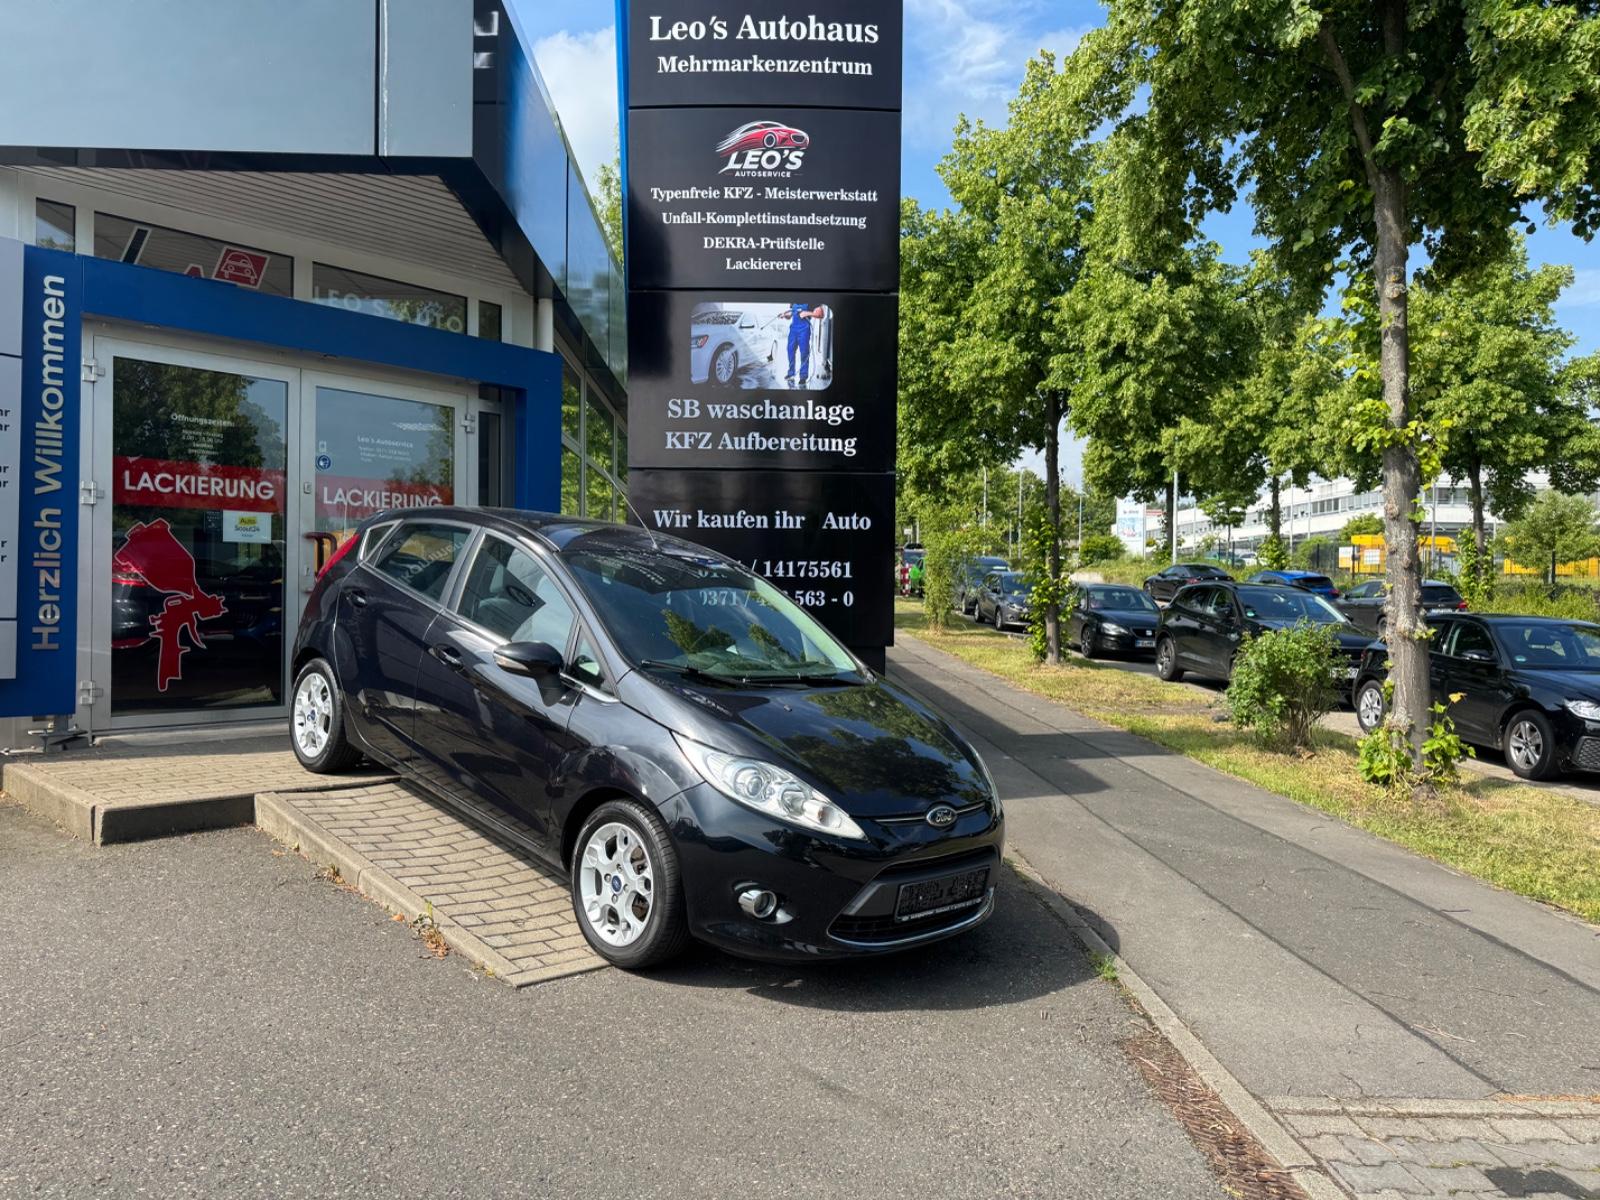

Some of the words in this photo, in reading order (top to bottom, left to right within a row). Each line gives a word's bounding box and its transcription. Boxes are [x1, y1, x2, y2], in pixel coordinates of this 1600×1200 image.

[649, 15, 728, 41] Leo's
[736, 14, 879, 44] Autohaus
[657, 54, 873, 76] Mehrmarkenzentrum
[724, 149, 805, 171] LEO'S
[734, 170, 791, 178] AUTOSERVICE
[650, 187, 720, 202] Typenfreie
[724, 186, 753, 199] KFZ
[765, 186, 878, 202] Meisterwerkstatt
[662, 212, 867, 230] Unfall-Komplettinstandsetzung
[703, 236, 825, 251] DEKRA-Prüfstelle
[34, 274, 66, 496] Willkommen
[667, 399, 701, 419] SB
[707, 399, 855, 426] waschanlage
[665, 432, 713, 450] KFZ
[718, 433, 857, 457] Aufbereitung
[123, 470, 276, 500] LACKIERUNG
[323, 486, 444, 508] LACKIERUNG
[653, 510, 692, 528] Wir
[697, 510, 768, 529] kaufen
[774, 510, 806, 529] ihr
[822, 511, 871, 530] Auto
[31, 507, 63, 651] Herzlich
[763, 560, 853, 578] 14175561
